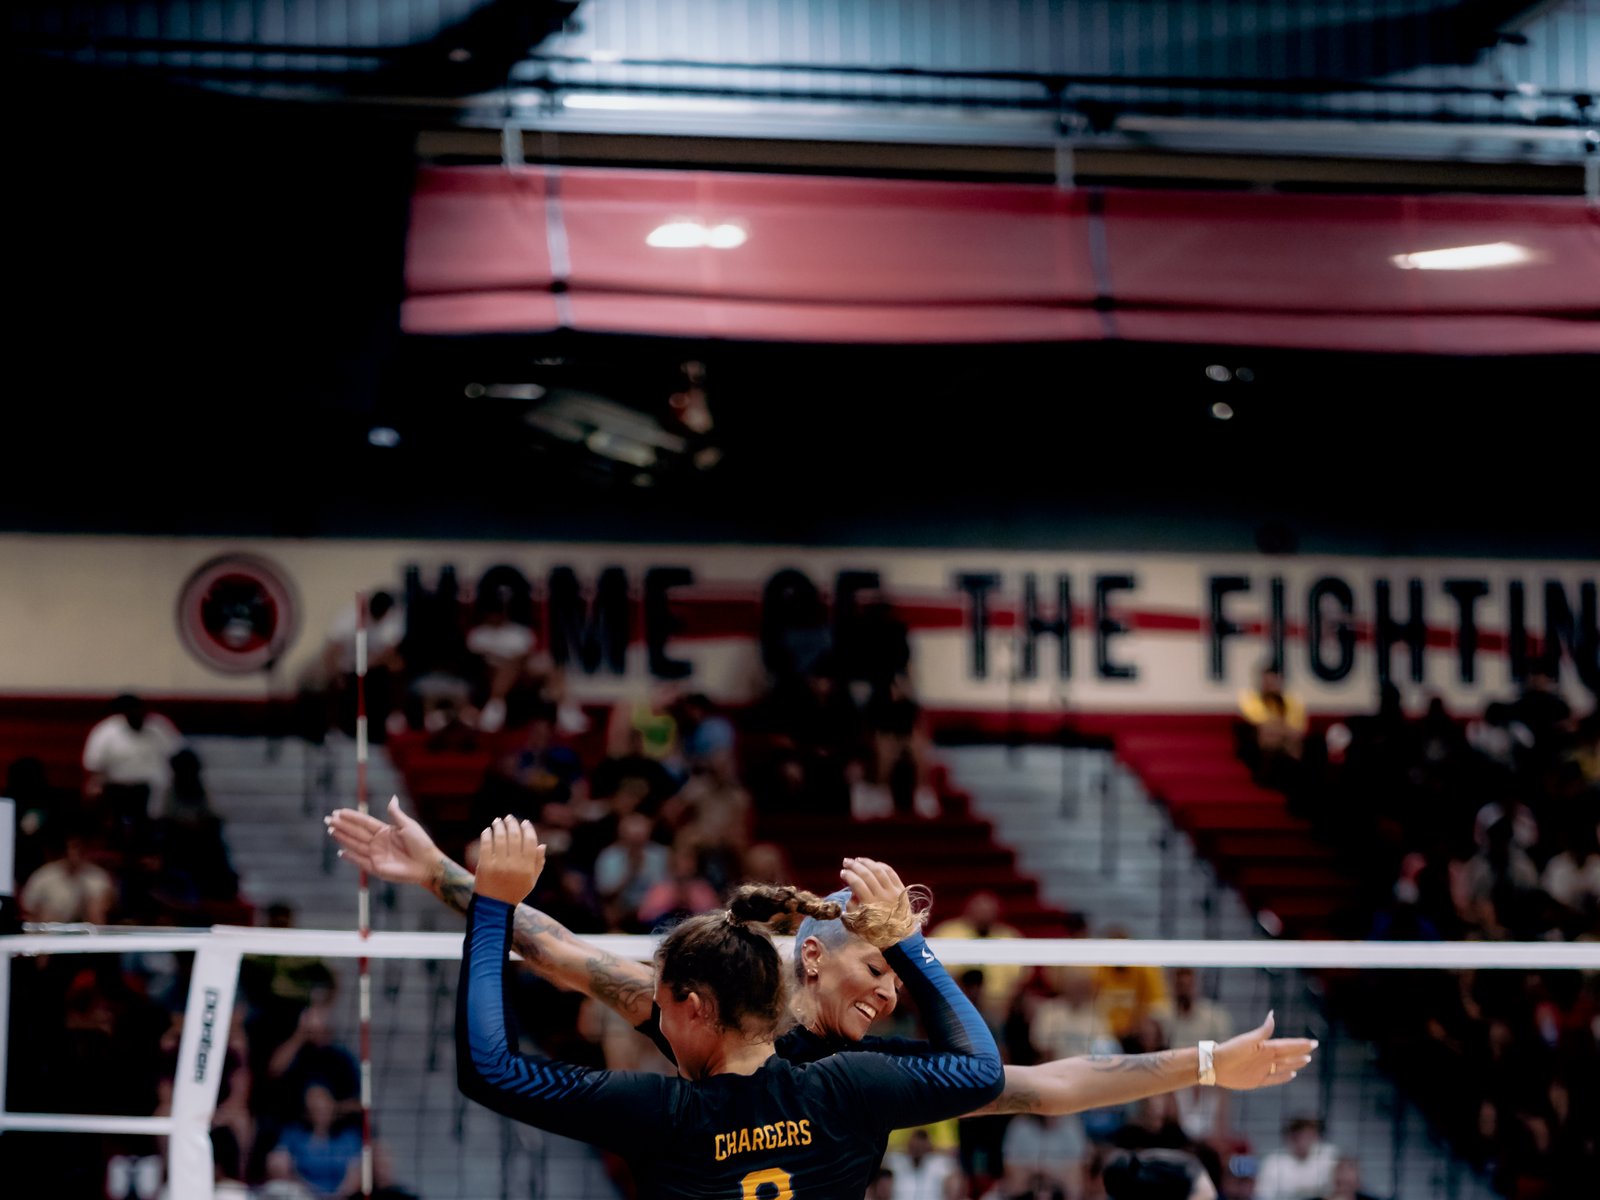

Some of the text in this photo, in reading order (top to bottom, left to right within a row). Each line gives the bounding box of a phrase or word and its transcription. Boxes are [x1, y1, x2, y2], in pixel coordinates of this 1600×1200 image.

[956, 572, 1137, 680] THE
[1210, 574, 1597, 686] FIGHTIN
[714, 1119, 812, 1161] CHARGERS
